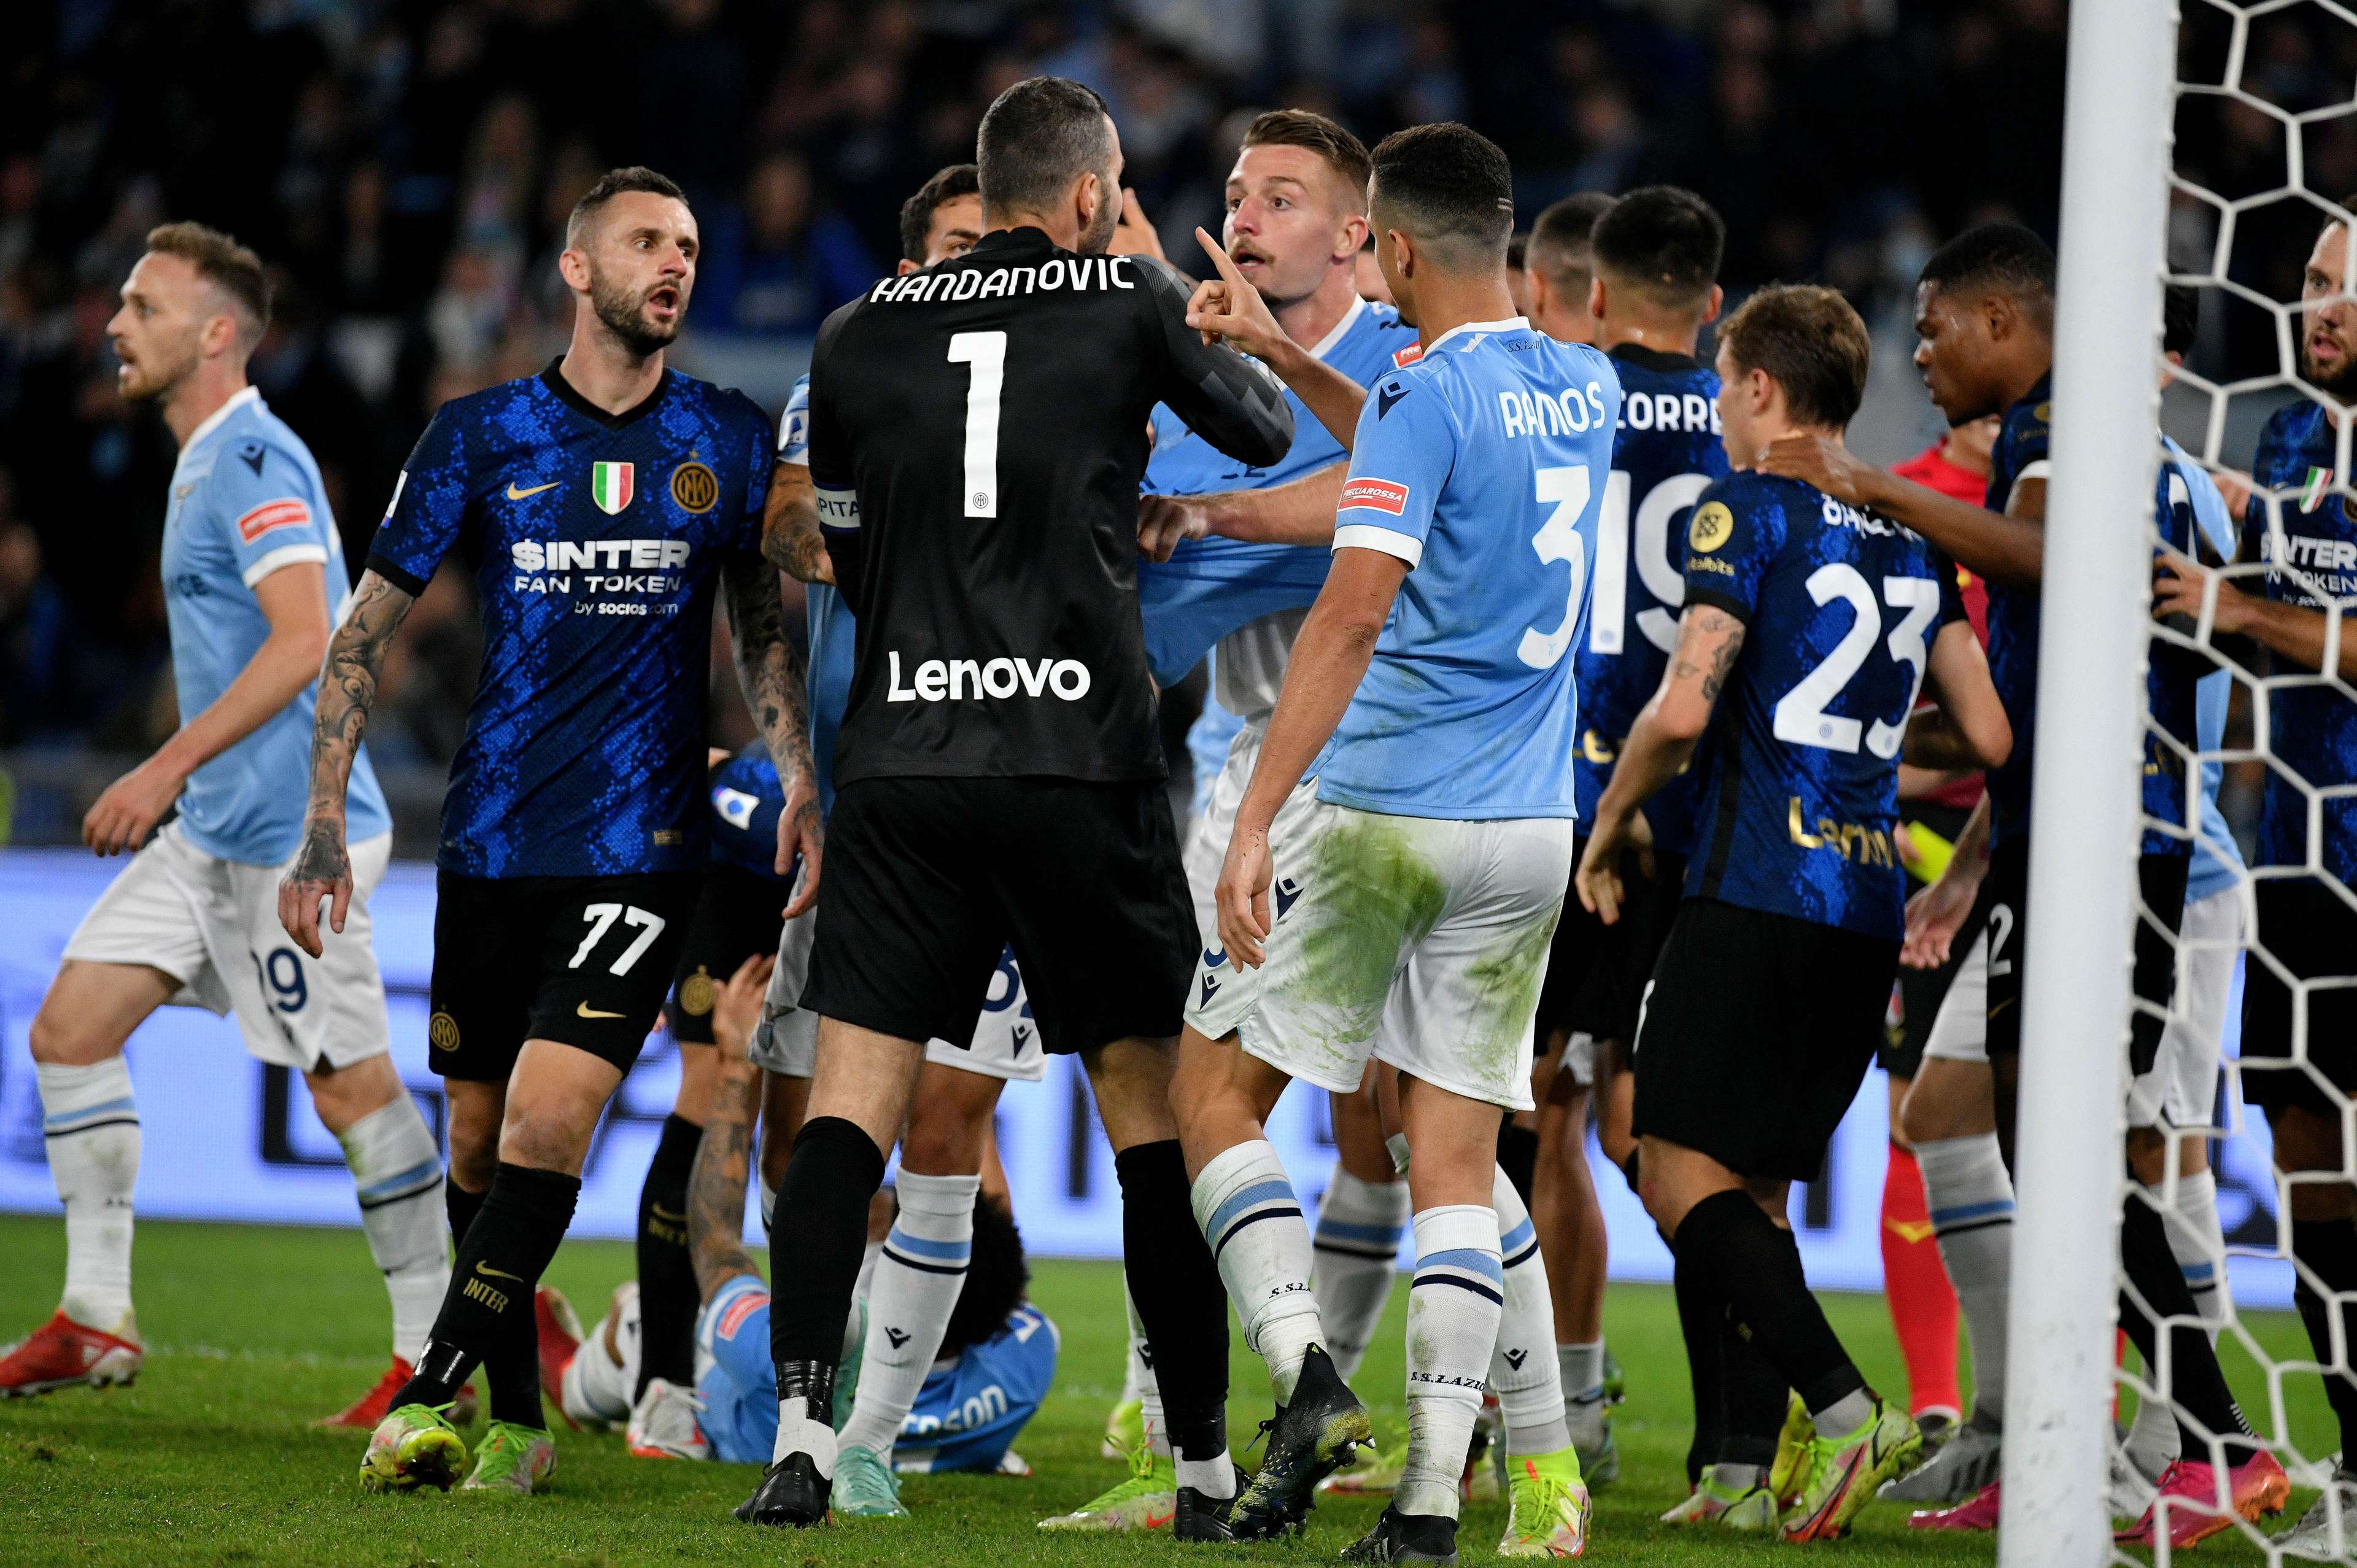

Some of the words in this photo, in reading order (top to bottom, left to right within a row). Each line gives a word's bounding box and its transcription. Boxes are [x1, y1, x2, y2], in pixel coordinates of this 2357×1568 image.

[947, 331, 1007, 518] 1
[1498, 381, 1606, 438] RAMOS
[1342, 487, 1403, 502] FRECCIAROSSA
[511, 538, 691, 574] $INTER
[1516, 464, 1591, 670] 3
[514, 575, 571, 595] FAN
[584, 574, 682, 594] TOKEN
[575, 600, 595, 616] by
[597, 602, 679, 616] sociosom
[887, 651, 1091, 702] Lenovo
[1773, 562, 1941, 760] 23
[568, 903, 667, 977] 77
[1988, 902, 2014, 979] 2
[463, 1277, 509, 1313] INTER
[1411, 1371, 1485, 1392] S.S.LAZIO
